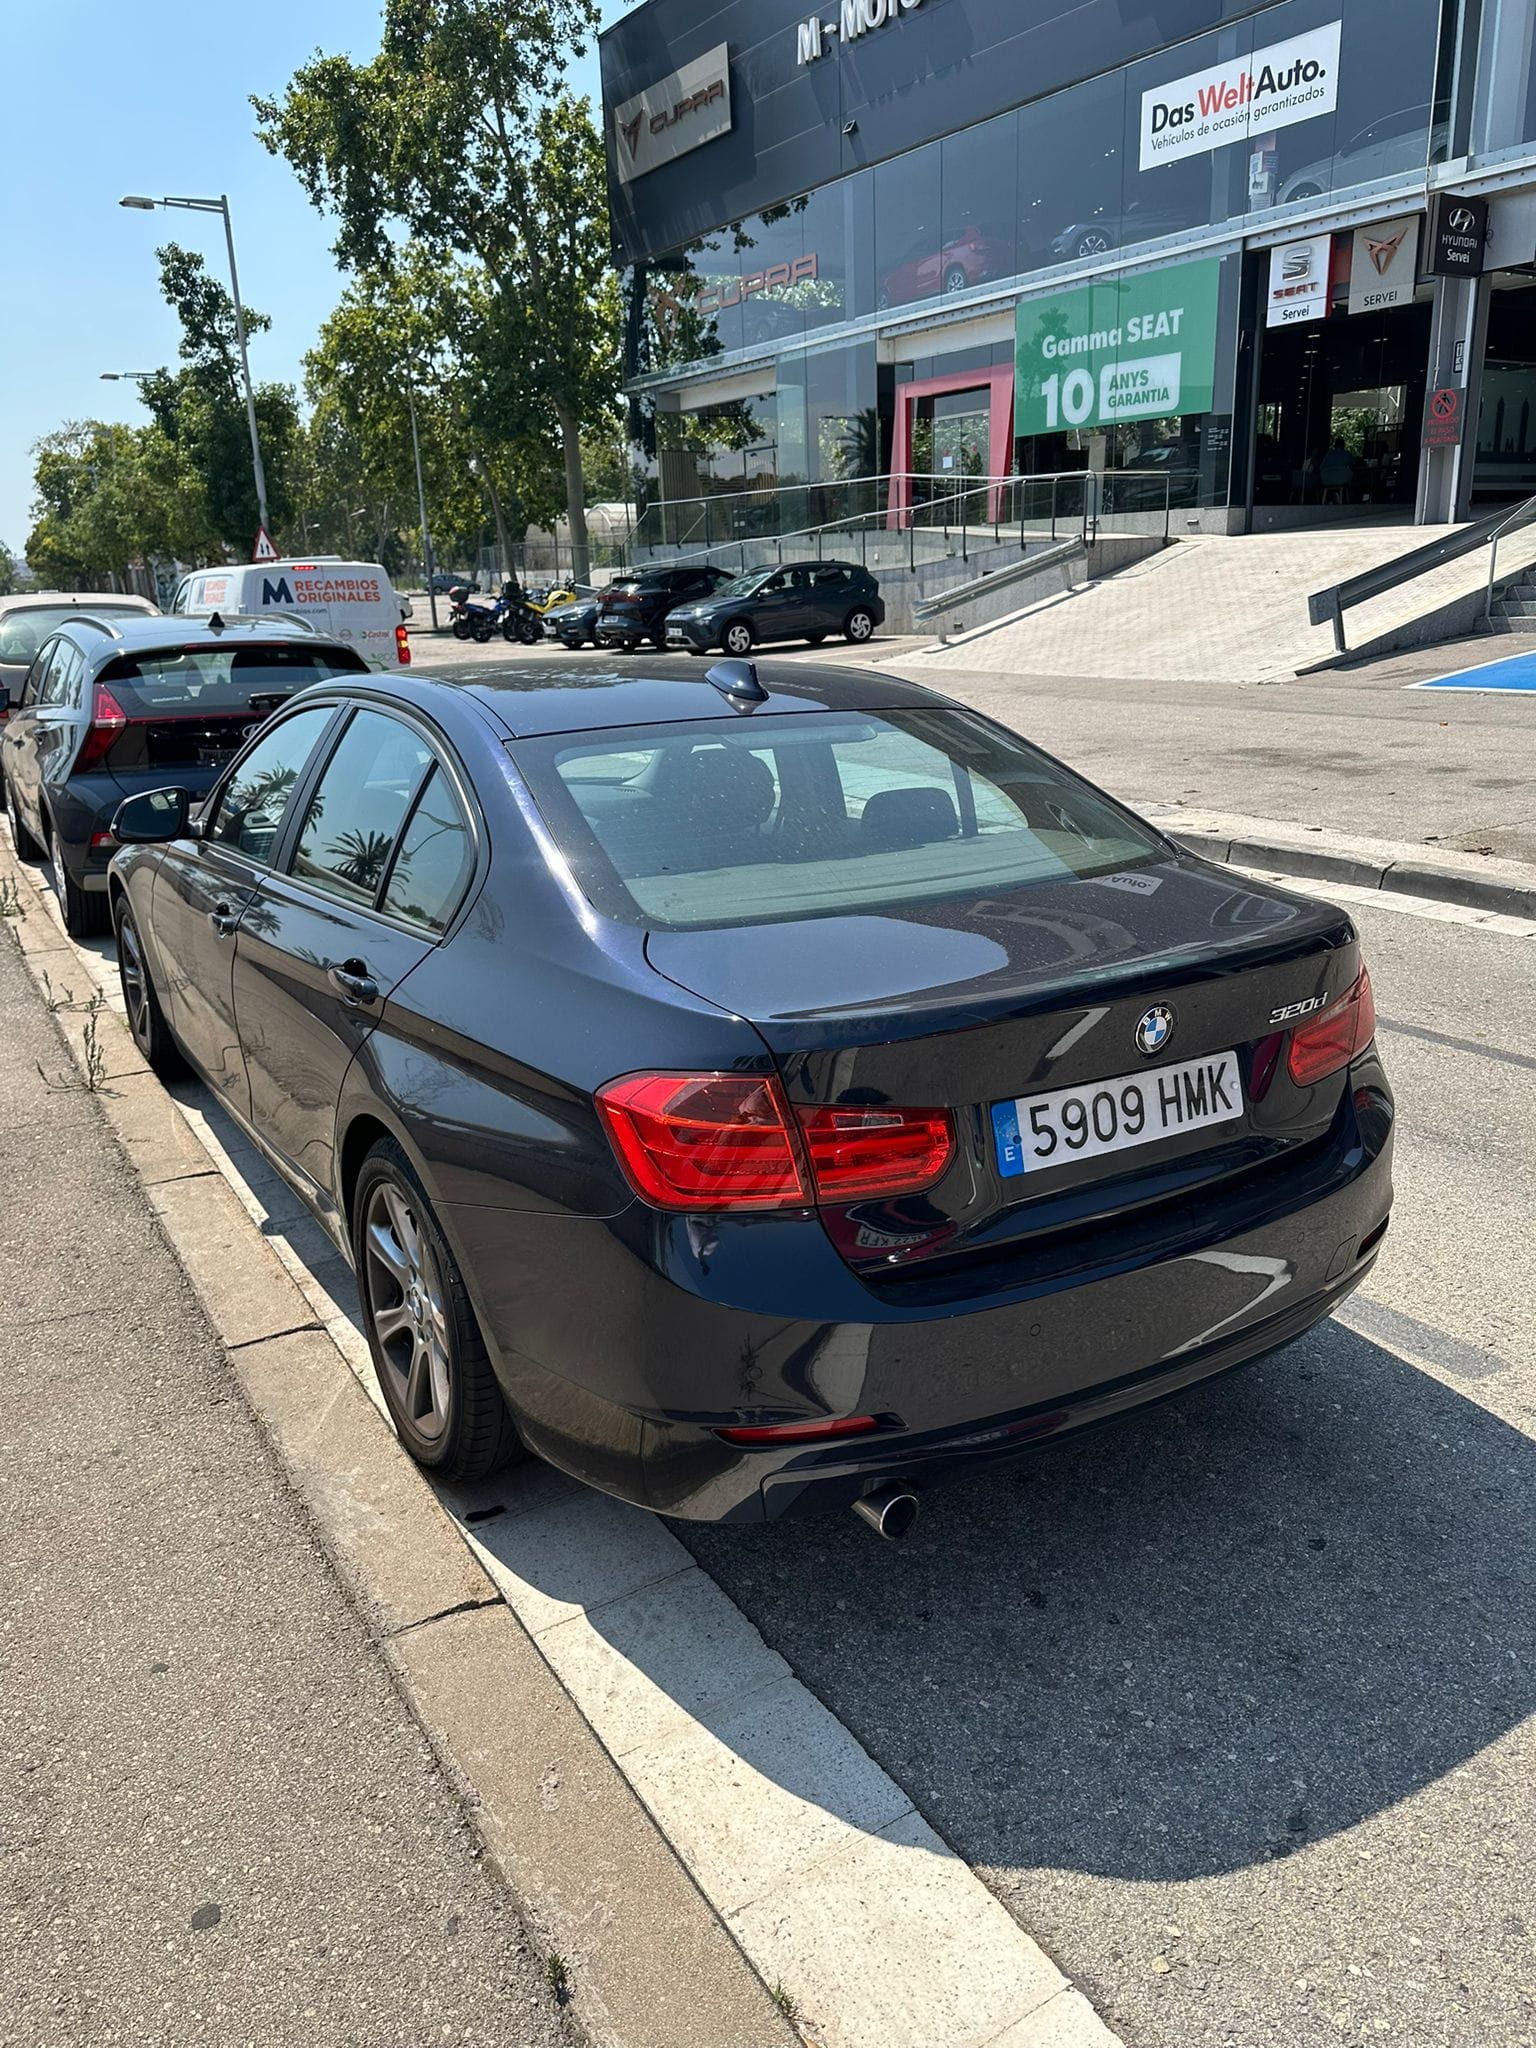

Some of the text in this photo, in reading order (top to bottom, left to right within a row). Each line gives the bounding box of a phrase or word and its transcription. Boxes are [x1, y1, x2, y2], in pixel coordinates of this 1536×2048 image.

[649, 79, 724, 135] CUPRA
[1151, 86, 1325, 151] Vehículos de ocasión garantizados
[1152, 103, 1195, 134] Das
[1442, 233, 1478, 249] HYUNDAI
[1447, 248, 1470, 263] Servei
[696, 252, 818, 315] CUPRA
[1273, 281, 1318, 299] SEAT
[1363, 290, 1398, 306] SERVEI
[1282, 304, 1310, 320] Servei
[1042, 307, 1184, 359] Gamma SEAT
[1109, 369, 1149, 391] ANYS
[1041, 368, 1095, 427] 10
[1108, 387, 1170, 408] GARANTIA
[262, 577, 294, 605] M
[294, 580, 379, 591] RECAMBIOS
[296, 591, 381, 603] ORIGINALES
[1142, 1007, 1173, 1026] BMW
[1268, 991, 1329, 1024] 320d
[1004, 1061, 1234, 1162] E 5909 HMK
